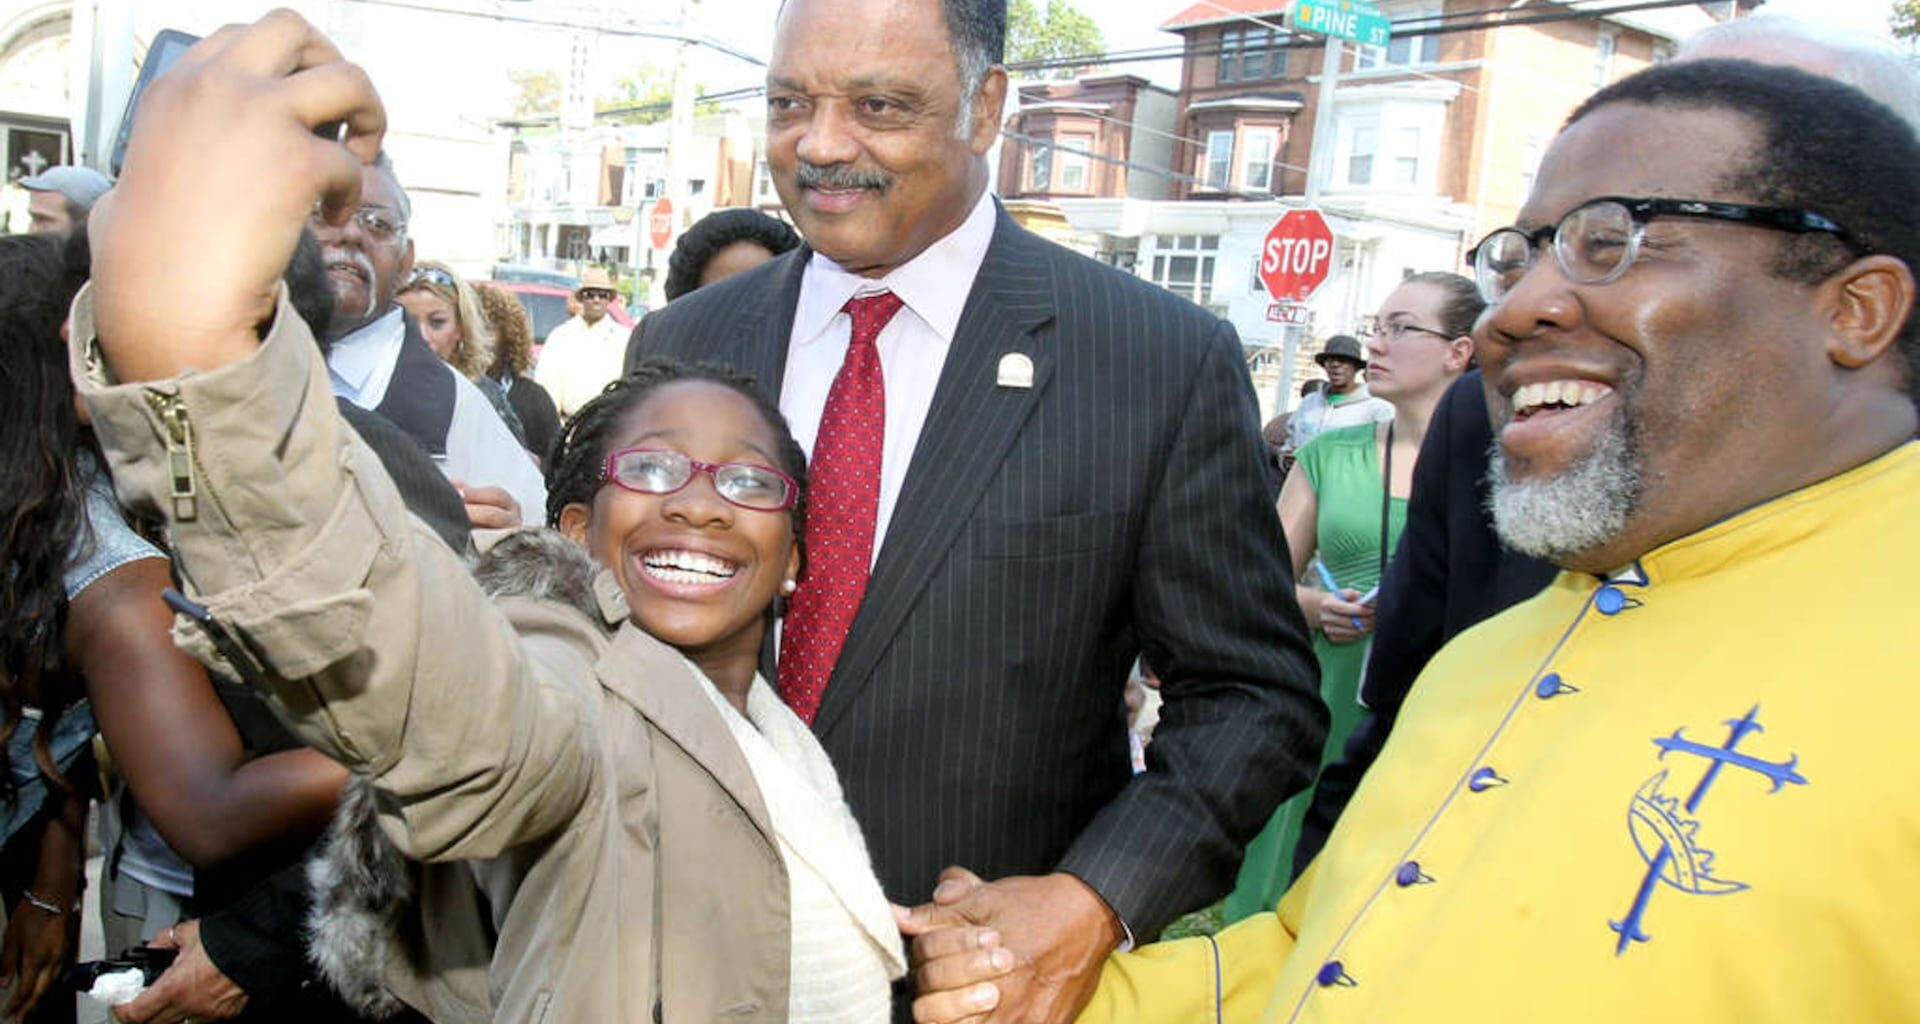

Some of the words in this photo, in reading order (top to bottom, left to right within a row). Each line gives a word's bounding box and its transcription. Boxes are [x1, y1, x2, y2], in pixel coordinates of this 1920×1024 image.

[1312, 6, 1358, 37] PINE
[1370, 26, 1386, 45] ST
[1264, 237, 1329, 275] STOP
